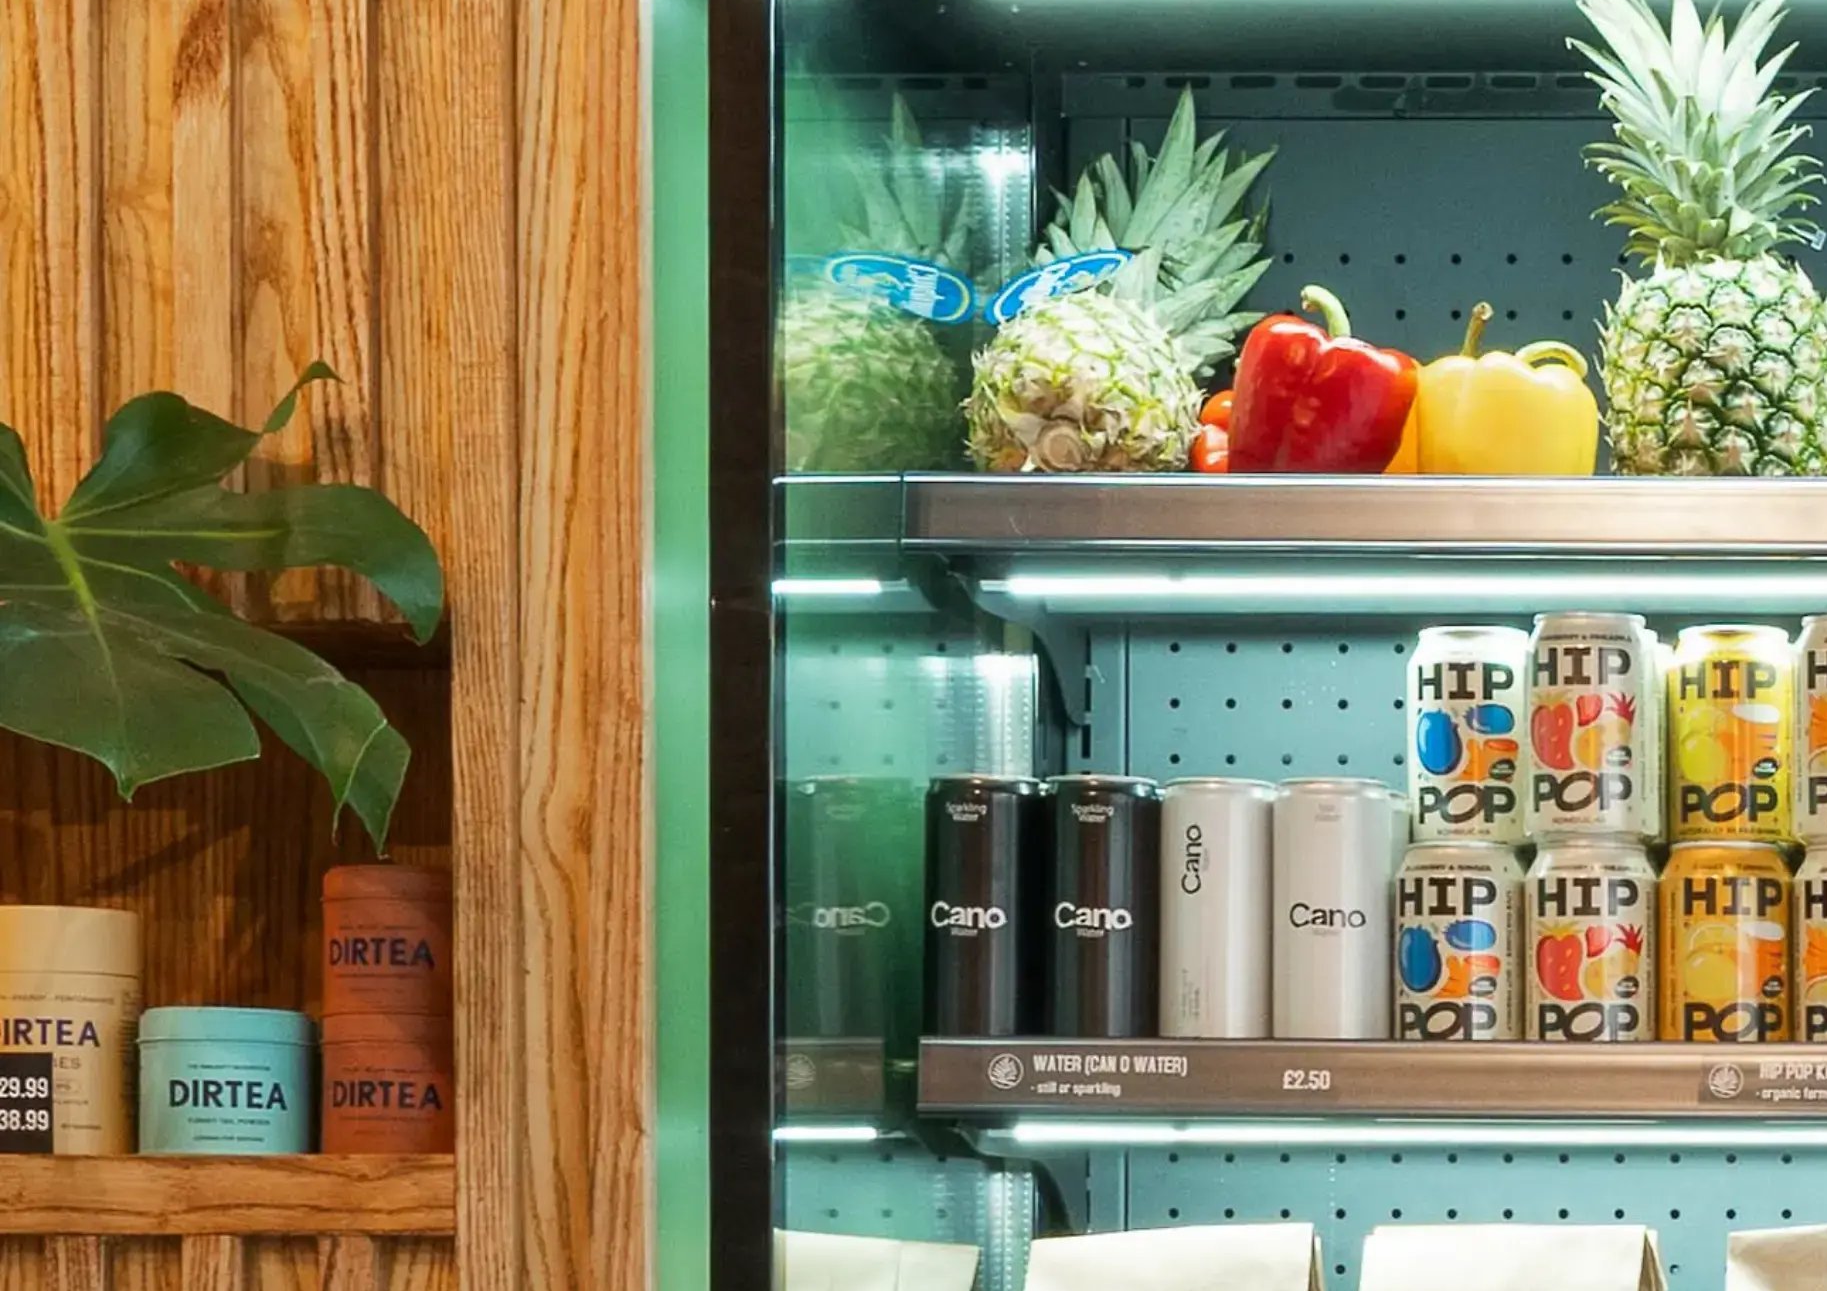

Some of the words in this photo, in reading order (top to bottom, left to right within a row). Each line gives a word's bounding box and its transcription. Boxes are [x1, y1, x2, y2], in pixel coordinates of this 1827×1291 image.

[1418, 662, 1513, 700] HIP
[1418, 784, 1516, 824] POP
[1181, 824, 1202, 894] Cano
[931, 900, 1007, 929] Cano
[1289, 902, 1366, 929] Cano
[330, 938, 434, 969] DIRTEA
[1034, 1055, 1082, 1072] WATER
[1085, 1056, 1116, 1076] (CAN
[1120, 1057, 1130, 1072] O
[1134, 1057, 1187, 1076] WATER)
[1284, 1070, 1330, 1090] £2.50
[1760, 1063, 1780, 1080] HIP
[1784, 1064, 1812, 1080] POP
[169, 1080, 287, 1110] DIRTEA
[333, 1081, 441, 1110] DIRTEA
